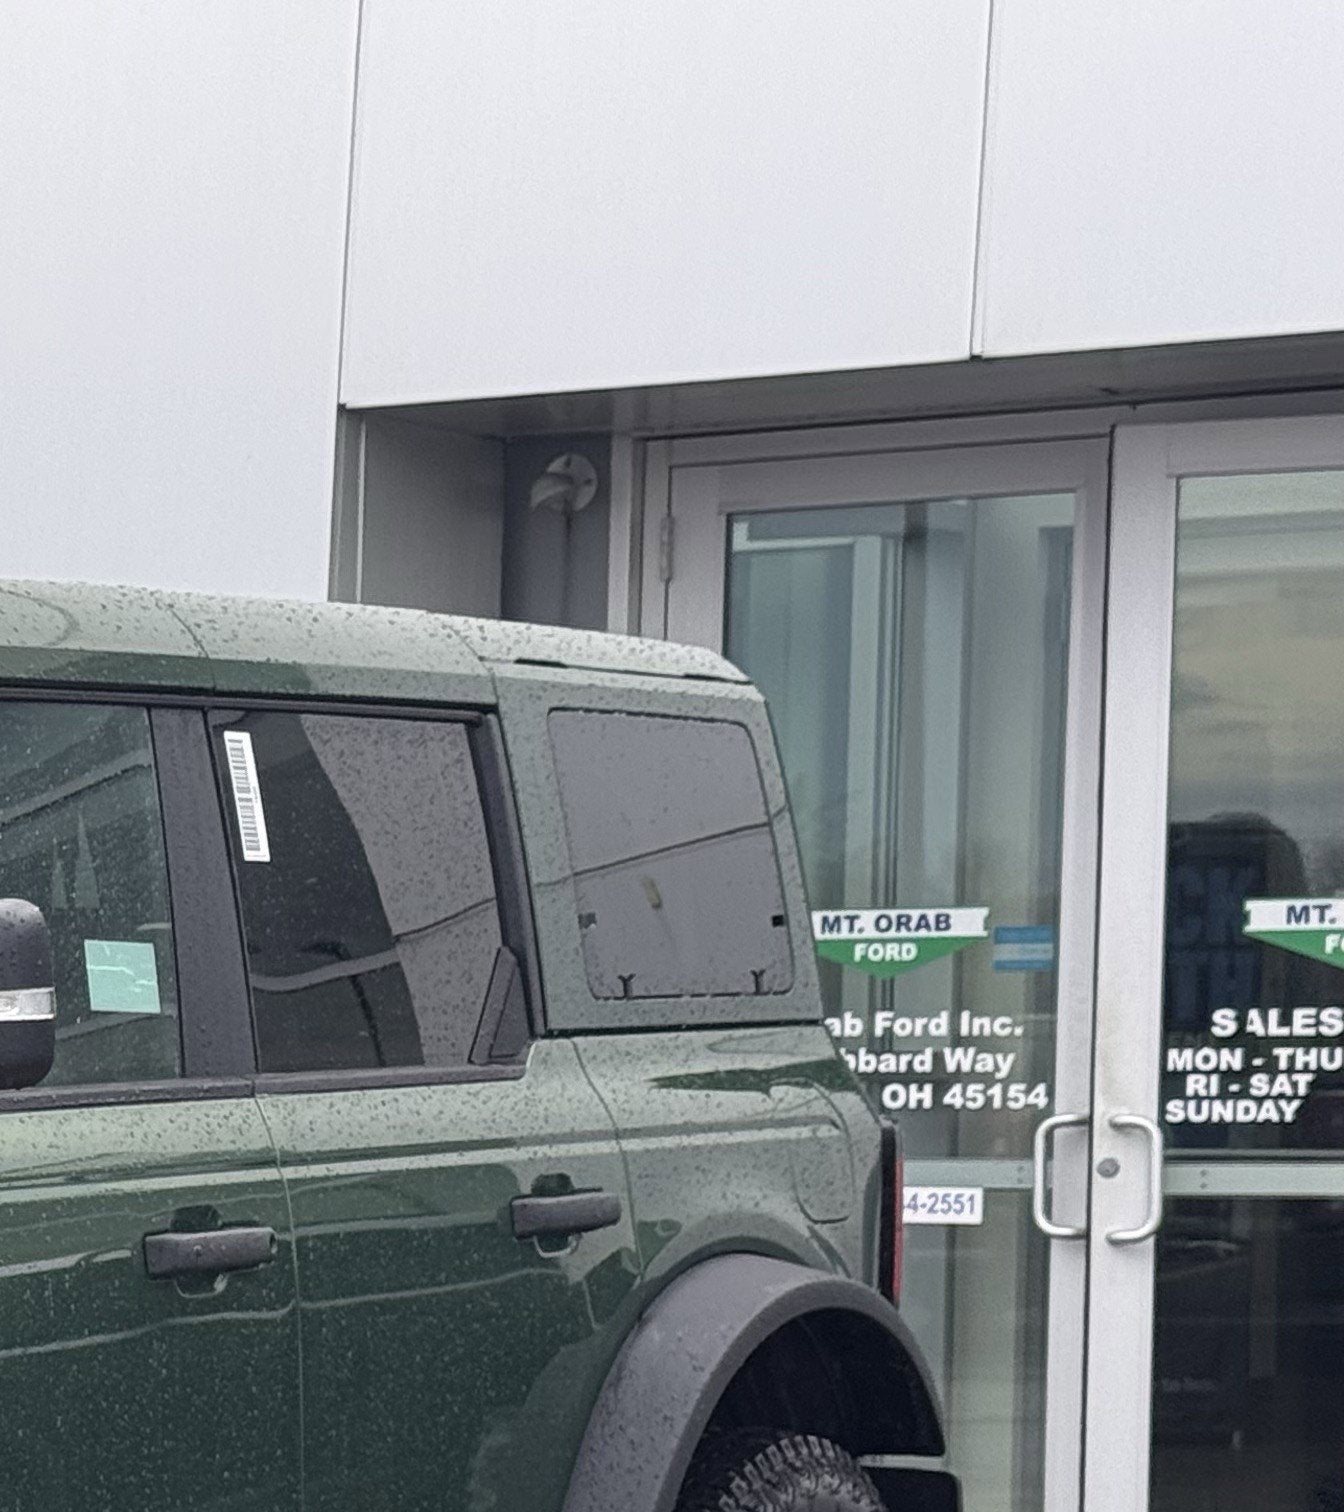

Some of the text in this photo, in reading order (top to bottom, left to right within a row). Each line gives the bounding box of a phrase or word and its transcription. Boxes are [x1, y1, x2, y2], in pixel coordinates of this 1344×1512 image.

[821, 913, 952, 934] MT. ORAB
[1286, 904, 1337, 925] MT.
[854, 943, 918, 962] FORD
[874, 1010, 950, 1037] Ford
[960, 1010, 1024, 1037] Inc.
[1212, 1007, 1344, 1037] SALES
[943, 1047, 1016, 1079] Way
[1167, 1048, 1244, 1072] MON
[882, 1082, 1049, 1109] OH 45154
[1249, 1072, 1317, 1096] SAT
[1165, 1099, 1302, 1123] SUNDAY
[904, 1193, 975, 1215] 4-2551
